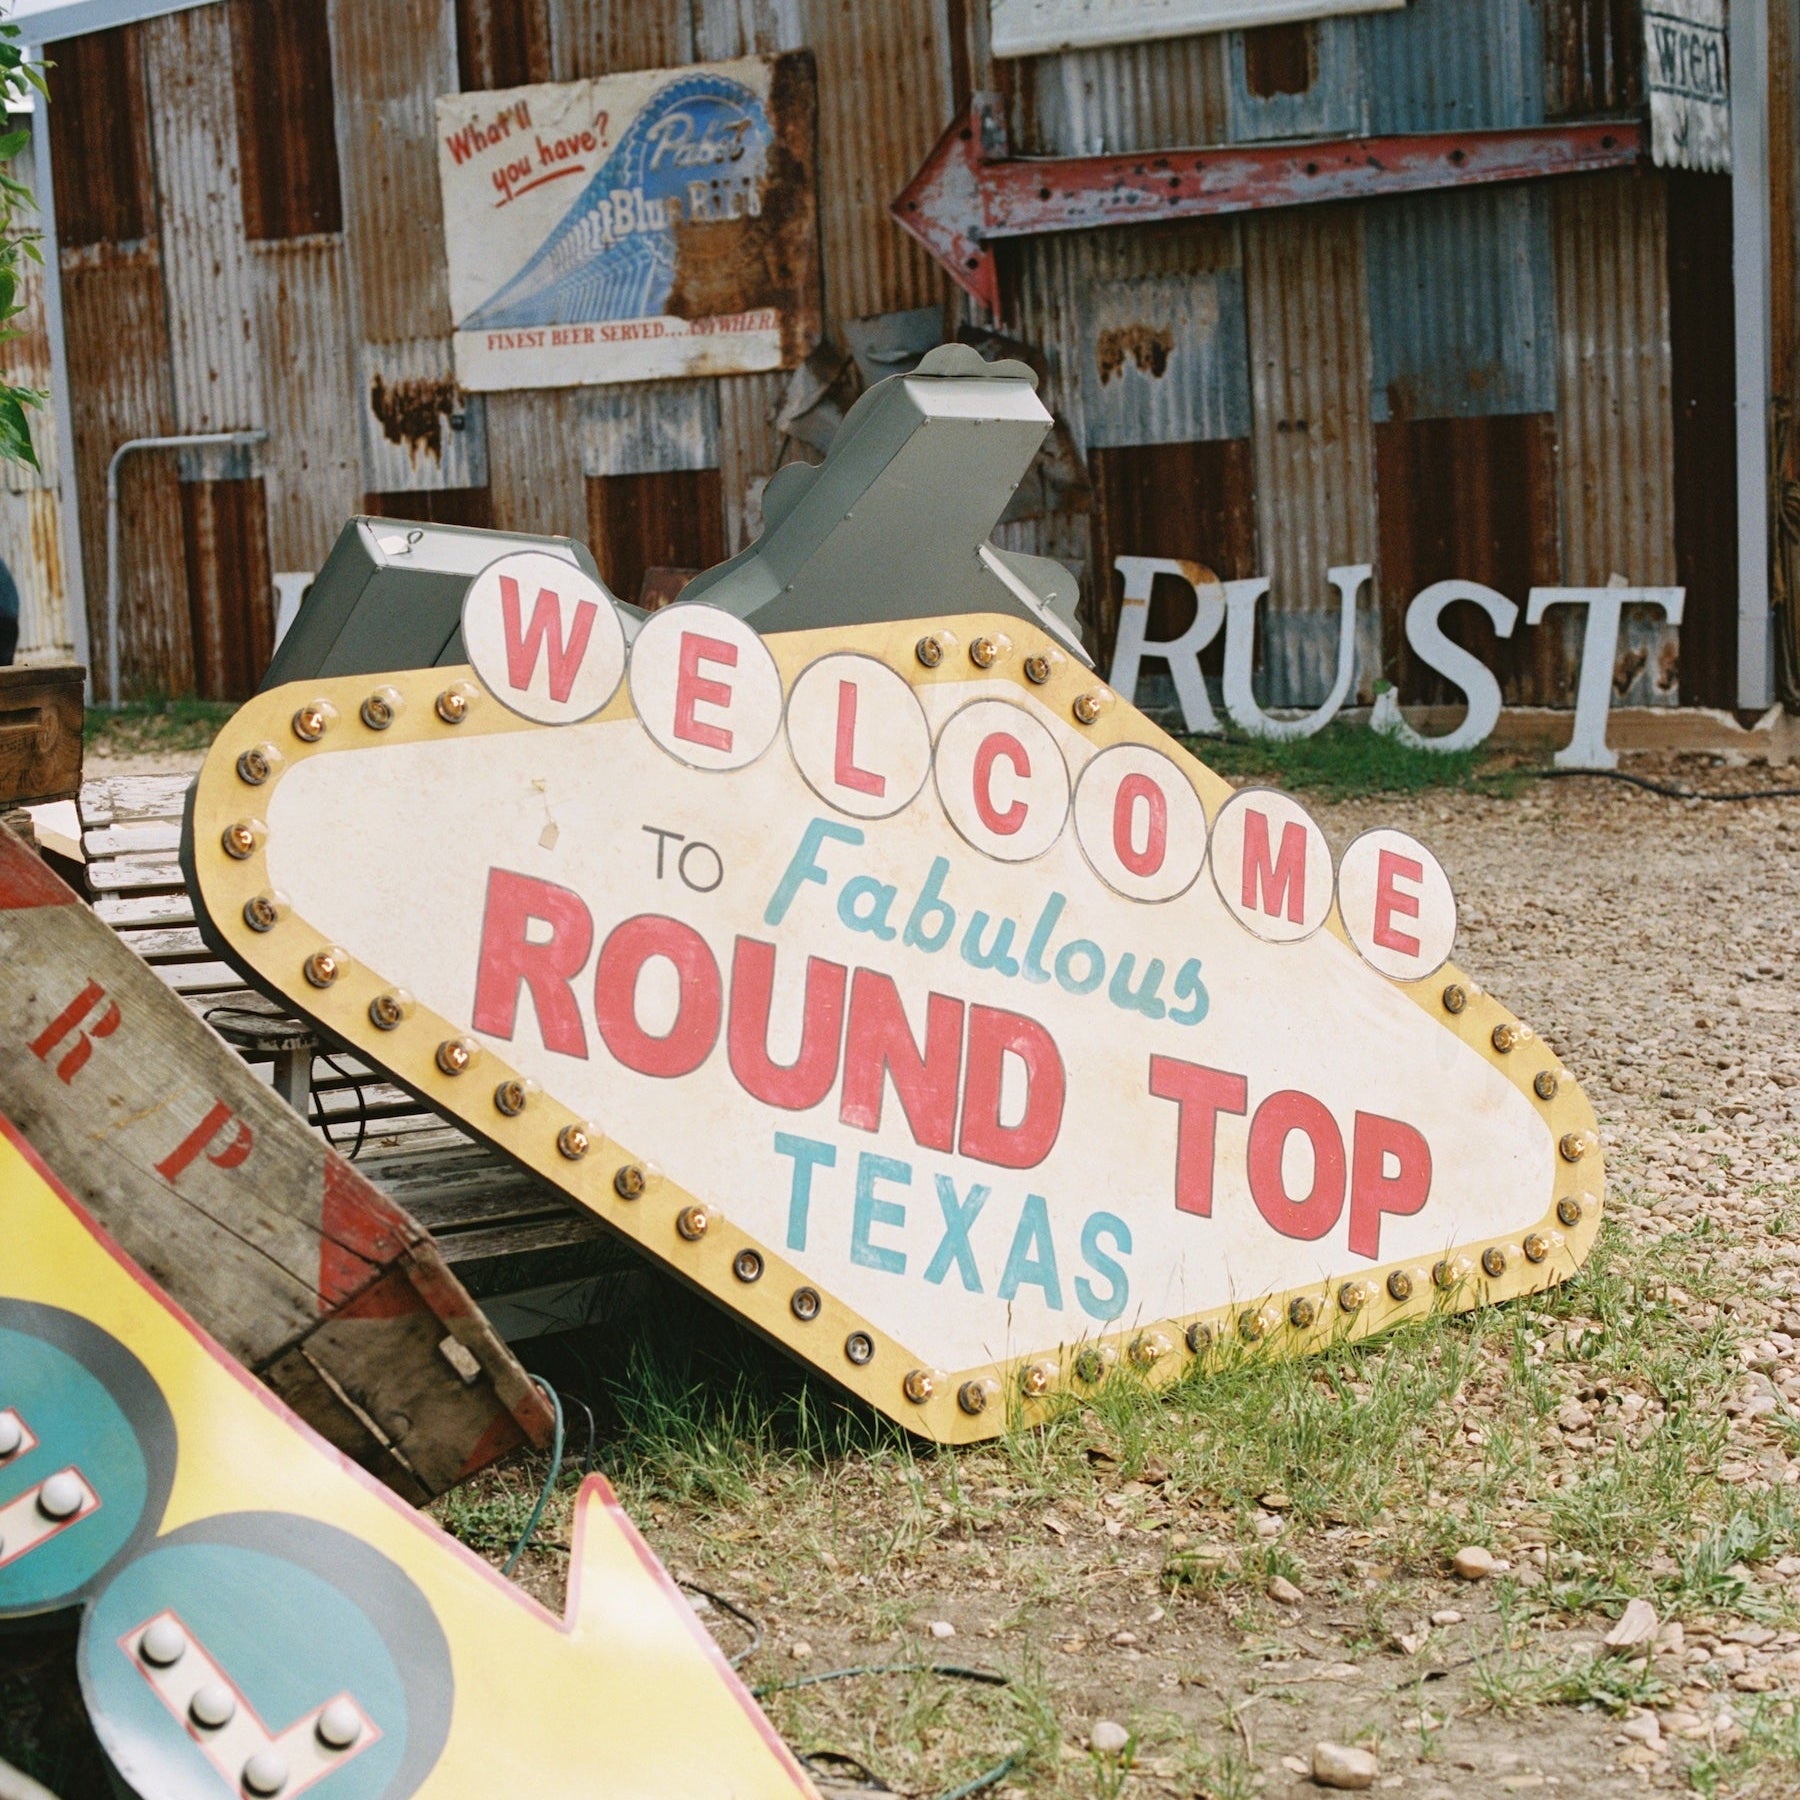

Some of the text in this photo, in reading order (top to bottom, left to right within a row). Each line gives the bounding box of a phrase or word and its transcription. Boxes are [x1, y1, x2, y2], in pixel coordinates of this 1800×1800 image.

[446, 100, 532, 166] What'll
[492, 110, 608, 203] you have?
[487, 331, 545, 351] FINEST
[551, 326, 595, 347] BEER
[499, 575, 1424, 957] WELCOME
[1108, 555, 1687, 770] RUST
[642, 816, 1210, 1026] TO Fabulous
[26, 977, 254, 1185] R P
[472, 867, 1433, 1260] ROUND TOP
[774, 1131, 1133, 1321] TEXAS
